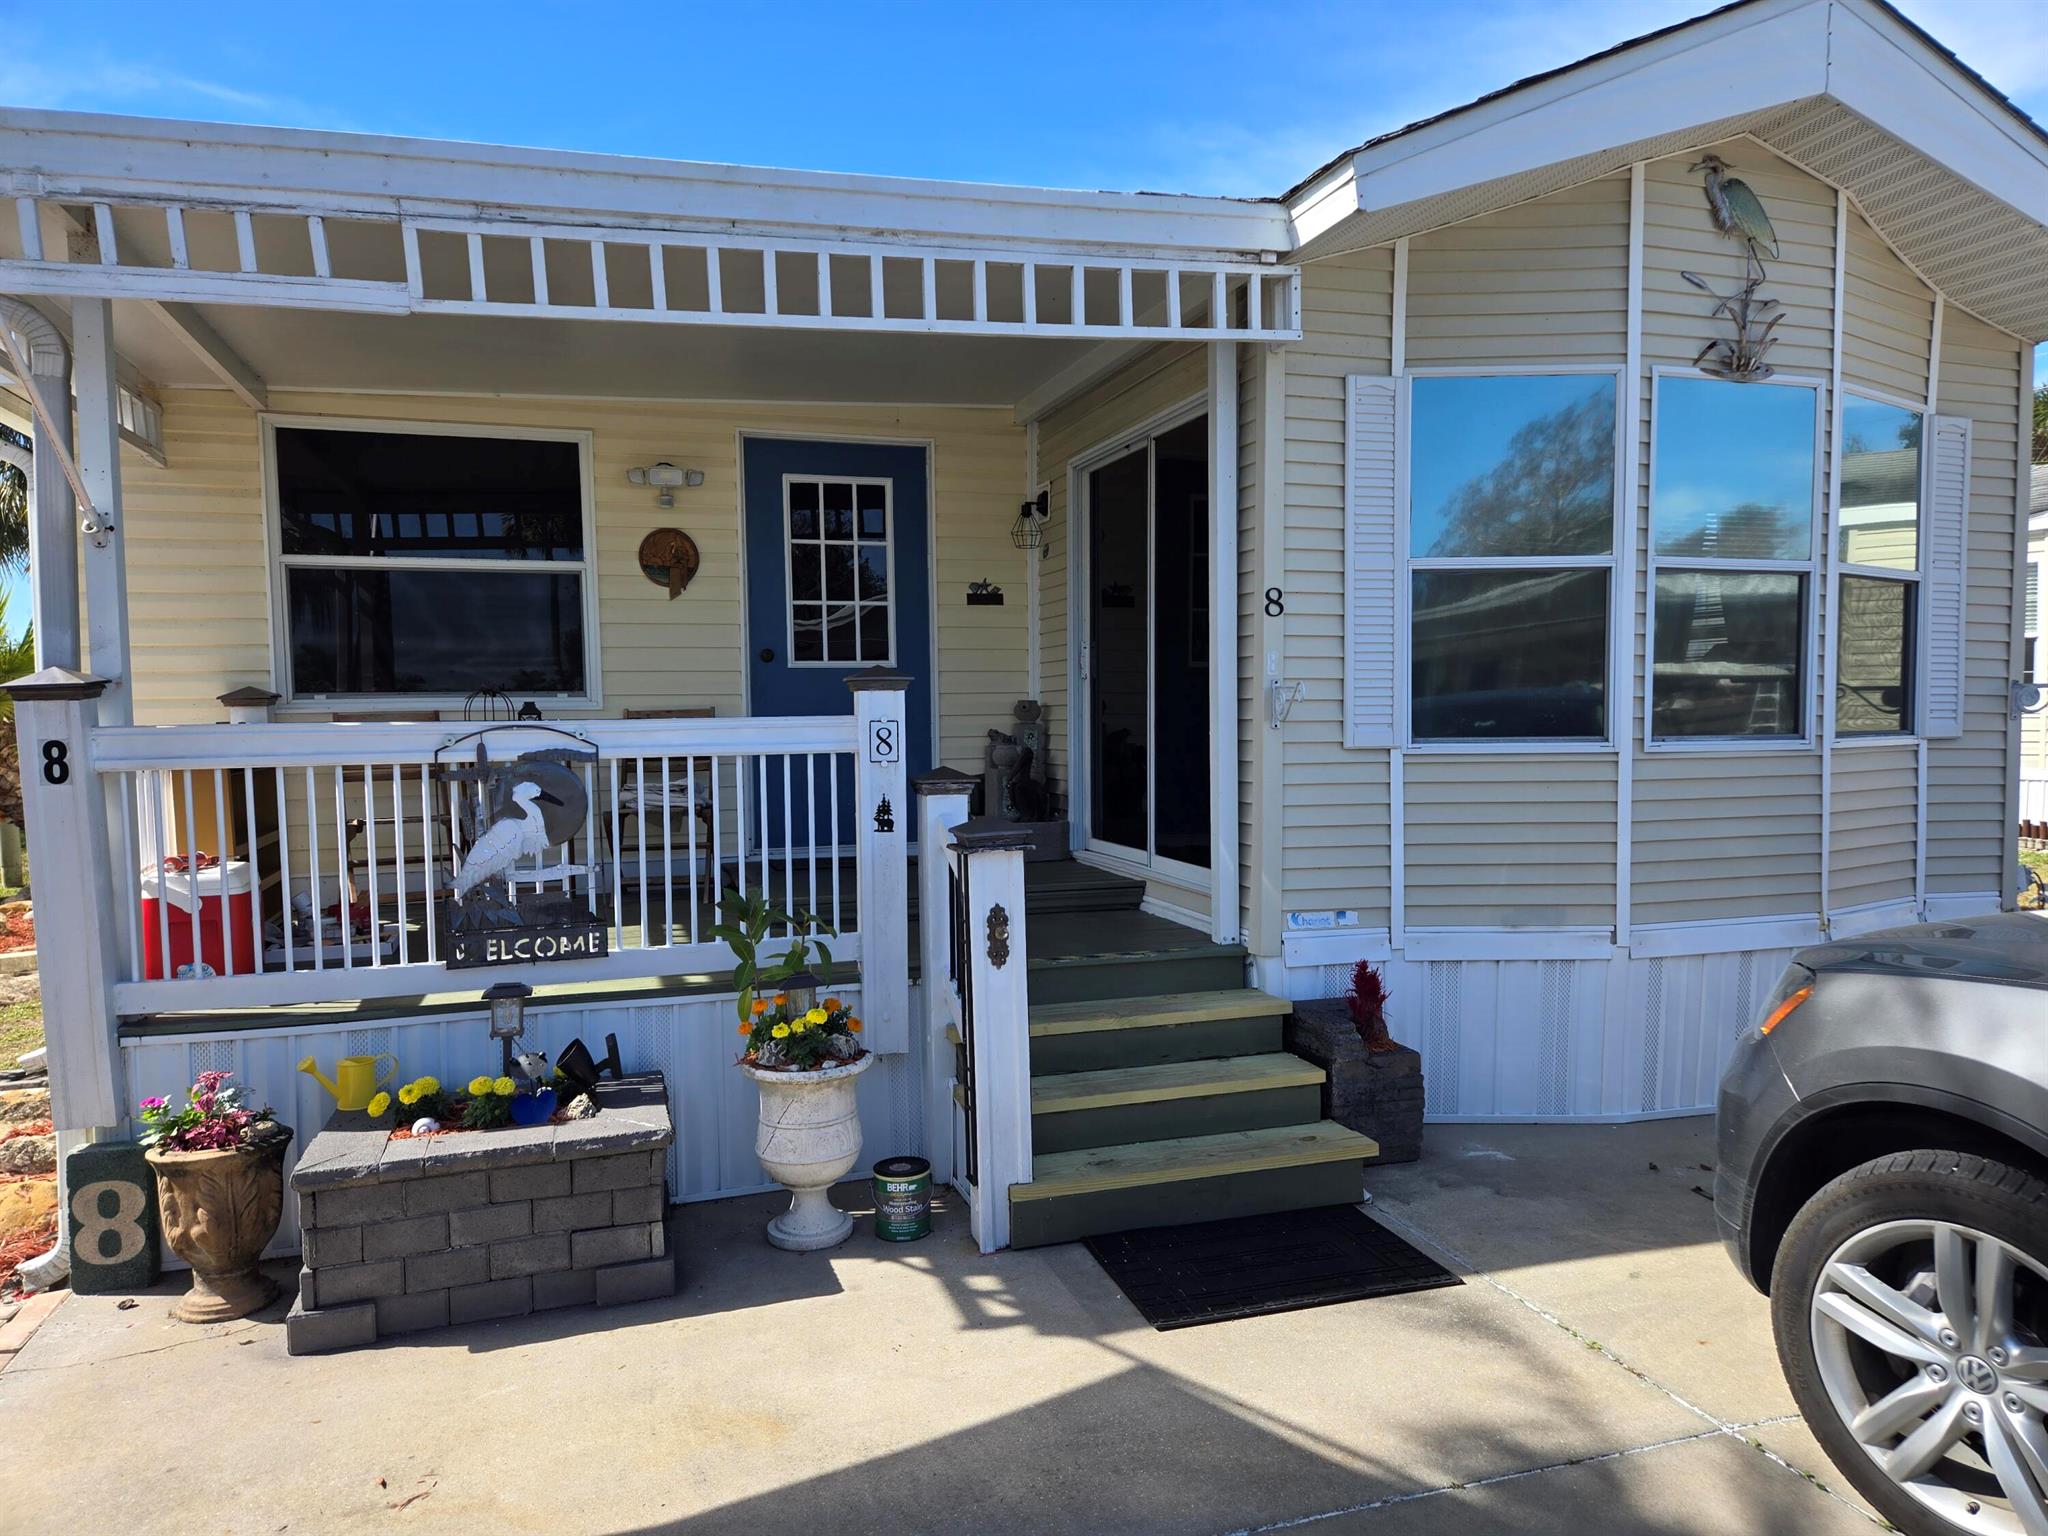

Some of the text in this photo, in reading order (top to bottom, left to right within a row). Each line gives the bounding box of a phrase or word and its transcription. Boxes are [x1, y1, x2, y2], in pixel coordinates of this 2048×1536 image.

[1264, 587, 1284, 618] 8
[875, 727, 893, 756] 8
[42, 740, 70, 785] 8
[887, 1183, 909, 1192] BEHR
[71, 1180, 147, 1265] 8
[882, 1204, 904, 1214] Wood
